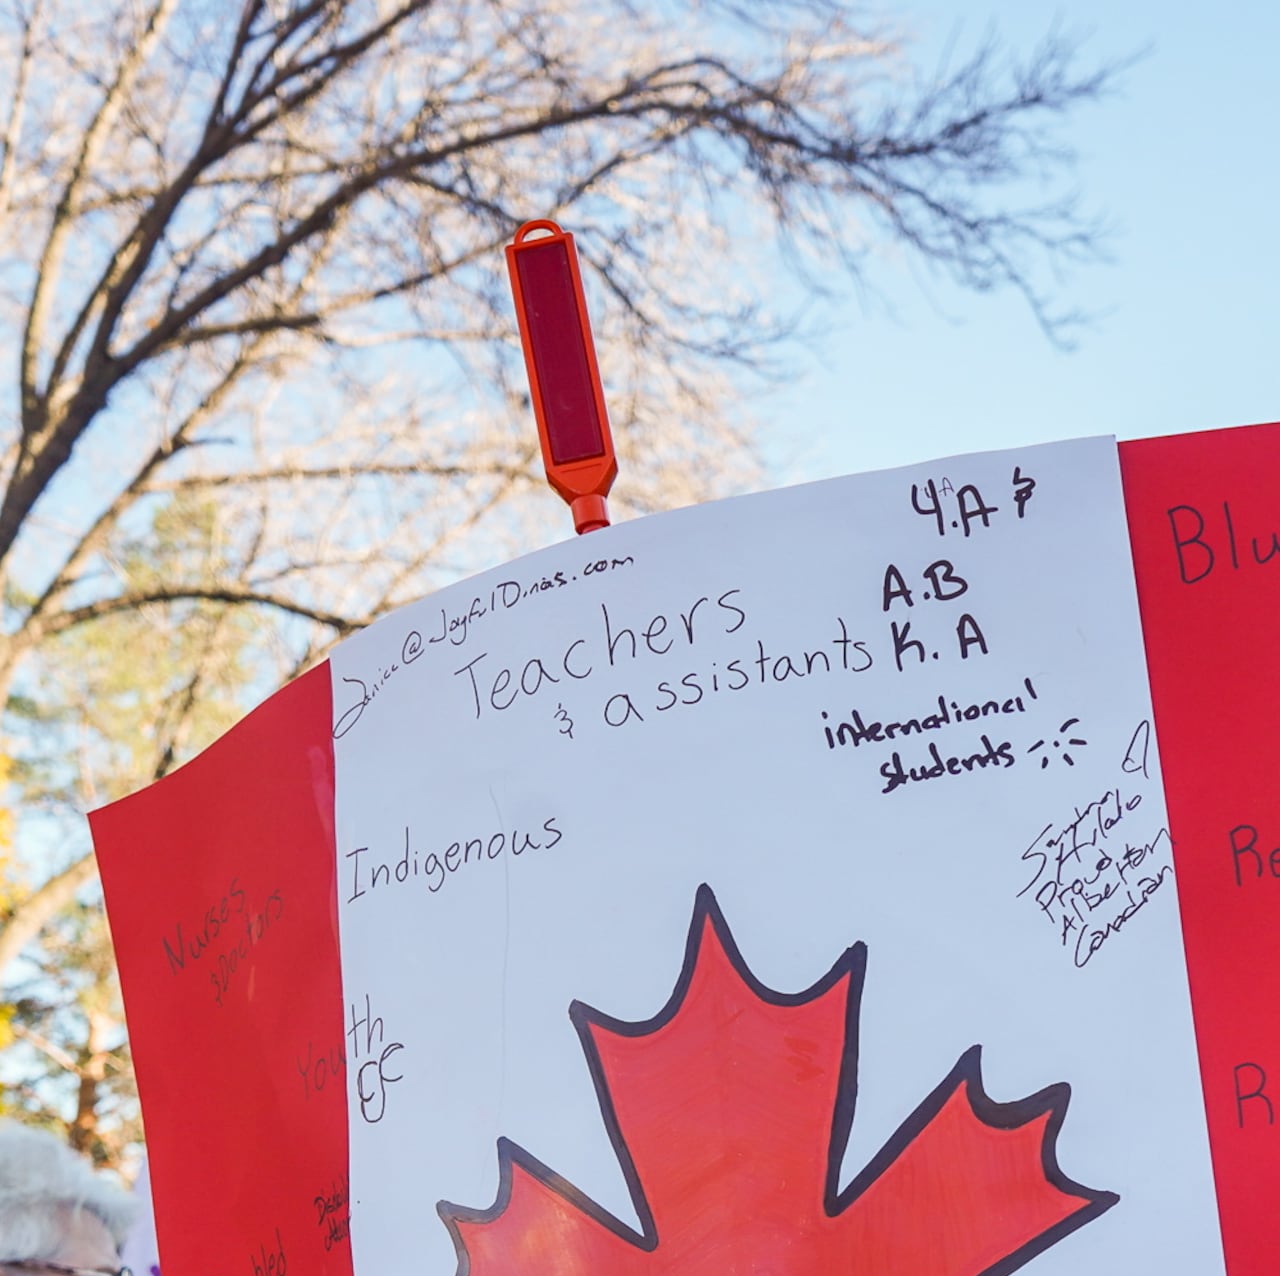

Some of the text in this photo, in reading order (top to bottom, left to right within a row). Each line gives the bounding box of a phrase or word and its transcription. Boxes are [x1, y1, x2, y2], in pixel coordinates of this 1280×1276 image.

[453, 588, 746, 720] Teachers
[603, 617, 874, 727] assistants
[821, 677, 1038, 750] international
[881, 734, 1015, 794] students
[345, 817, 563, 904] Indigenous
[161, 876, 246, 977] Nurses
